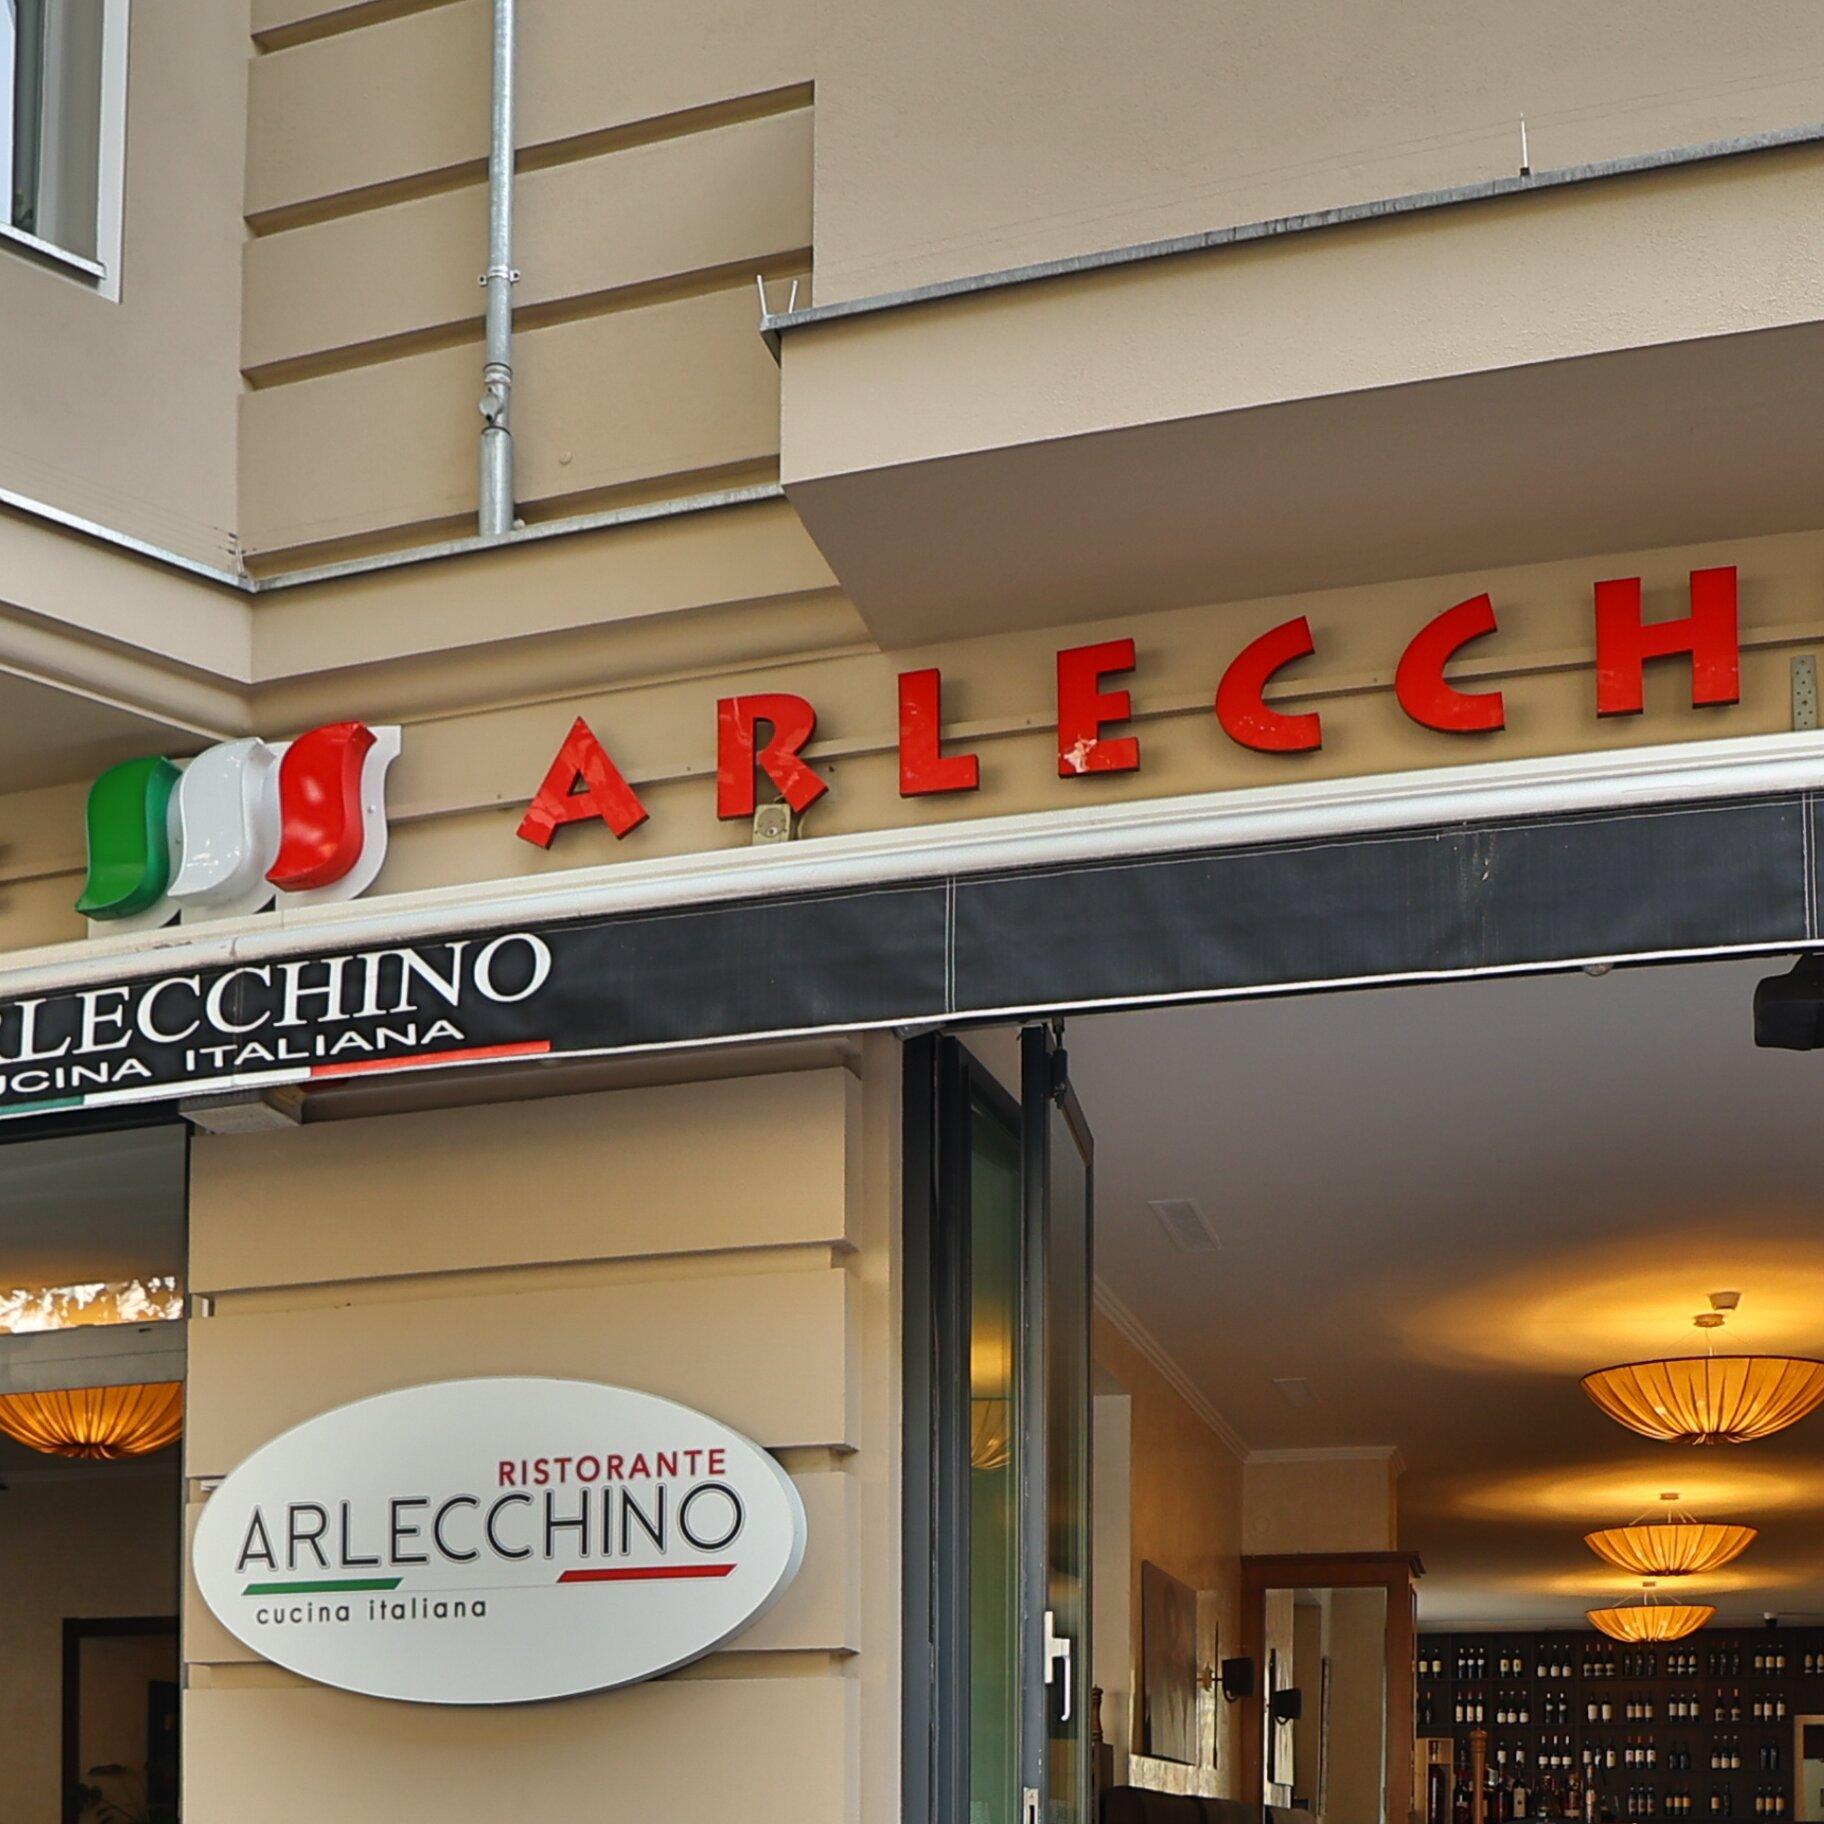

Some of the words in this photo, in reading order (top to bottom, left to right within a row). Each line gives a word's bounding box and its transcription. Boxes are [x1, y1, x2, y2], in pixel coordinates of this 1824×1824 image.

[185, 1018, 465, 1073] ITALIANA
[498, 1448, 728, 1487] RISTORANTE
[234, 1480, 747, 1574] ARLECCHINO
[255, 1599, 351, 1625] cucina
[367, 1596, 488, 1622] italiana
